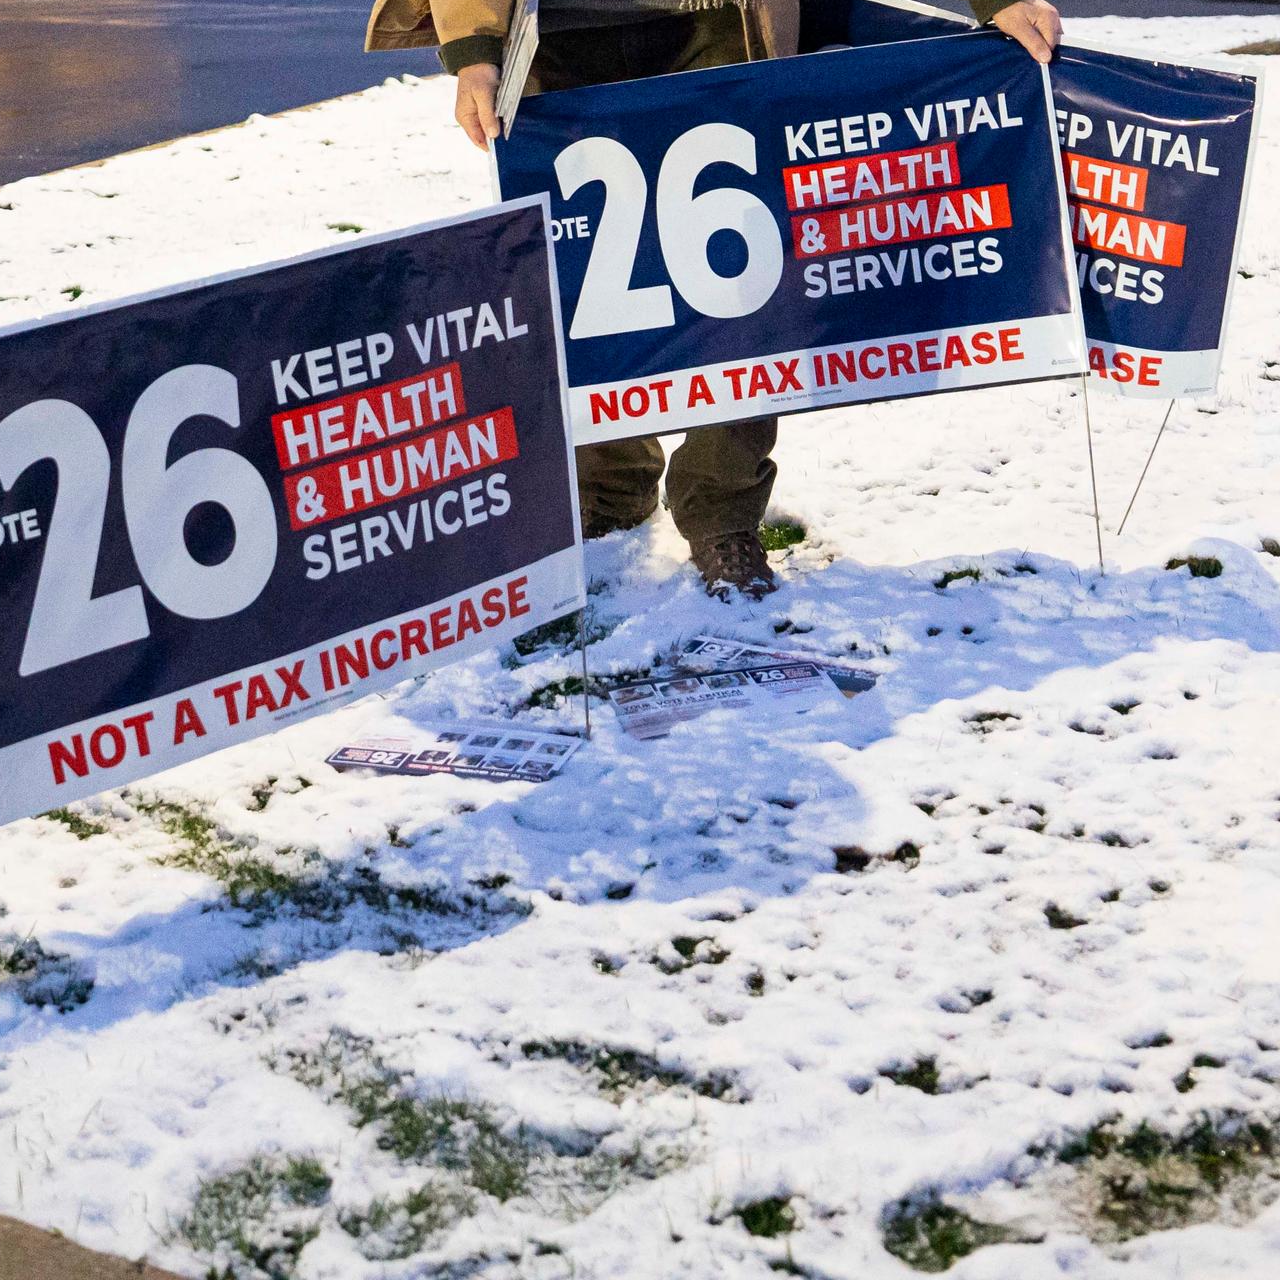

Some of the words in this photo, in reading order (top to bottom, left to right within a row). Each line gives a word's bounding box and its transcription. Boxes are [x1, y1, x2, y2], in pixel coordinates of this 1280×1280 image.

[784, 111, 893, 161] KEEP
[904, 92, 1023, 142] VITAL
[1055, 109, 1093, 147] EP
[1107, 120, 1220, 176] VITAL
[791, 149, 953, 208] HEALTH
[1070, 160, 1138, 208] LTH
[550, 216, 590, 241] OTE
[553, 122, 784, 340] 26
[800, 218, 826, 254] &
[839, 190, 993, 247] HUMAN
[1069, 205, 1166, 260] MAN
[803, 237, 1003, 299] SERVICES
[1077, 251, 1164, 305] ICES
[271, 332, 394, 405] KEEP
[406, 297, 529, 365] VITAL
[588, 380, 673, 425] NOT
[687, 374, 716, 409] A
[723, 357, 804, 400] TAX
[813, 327, 1025, 389] INCREASE
[282, 372, 457, 465] HEALTH
[295, 476, 327, 523] &
[338, 417, 499, 510] HUMAN
[303, 472, 512, 580] SERVICES
[47, 711, 154, 785] NOT
[174, 698, 207, 745] A
[213, 660, 311, 727] TAX
[319, 575, 531, 691] INCREASE
[756, 670, 786, 682] 26
[369, 751, 398, 765] 26
